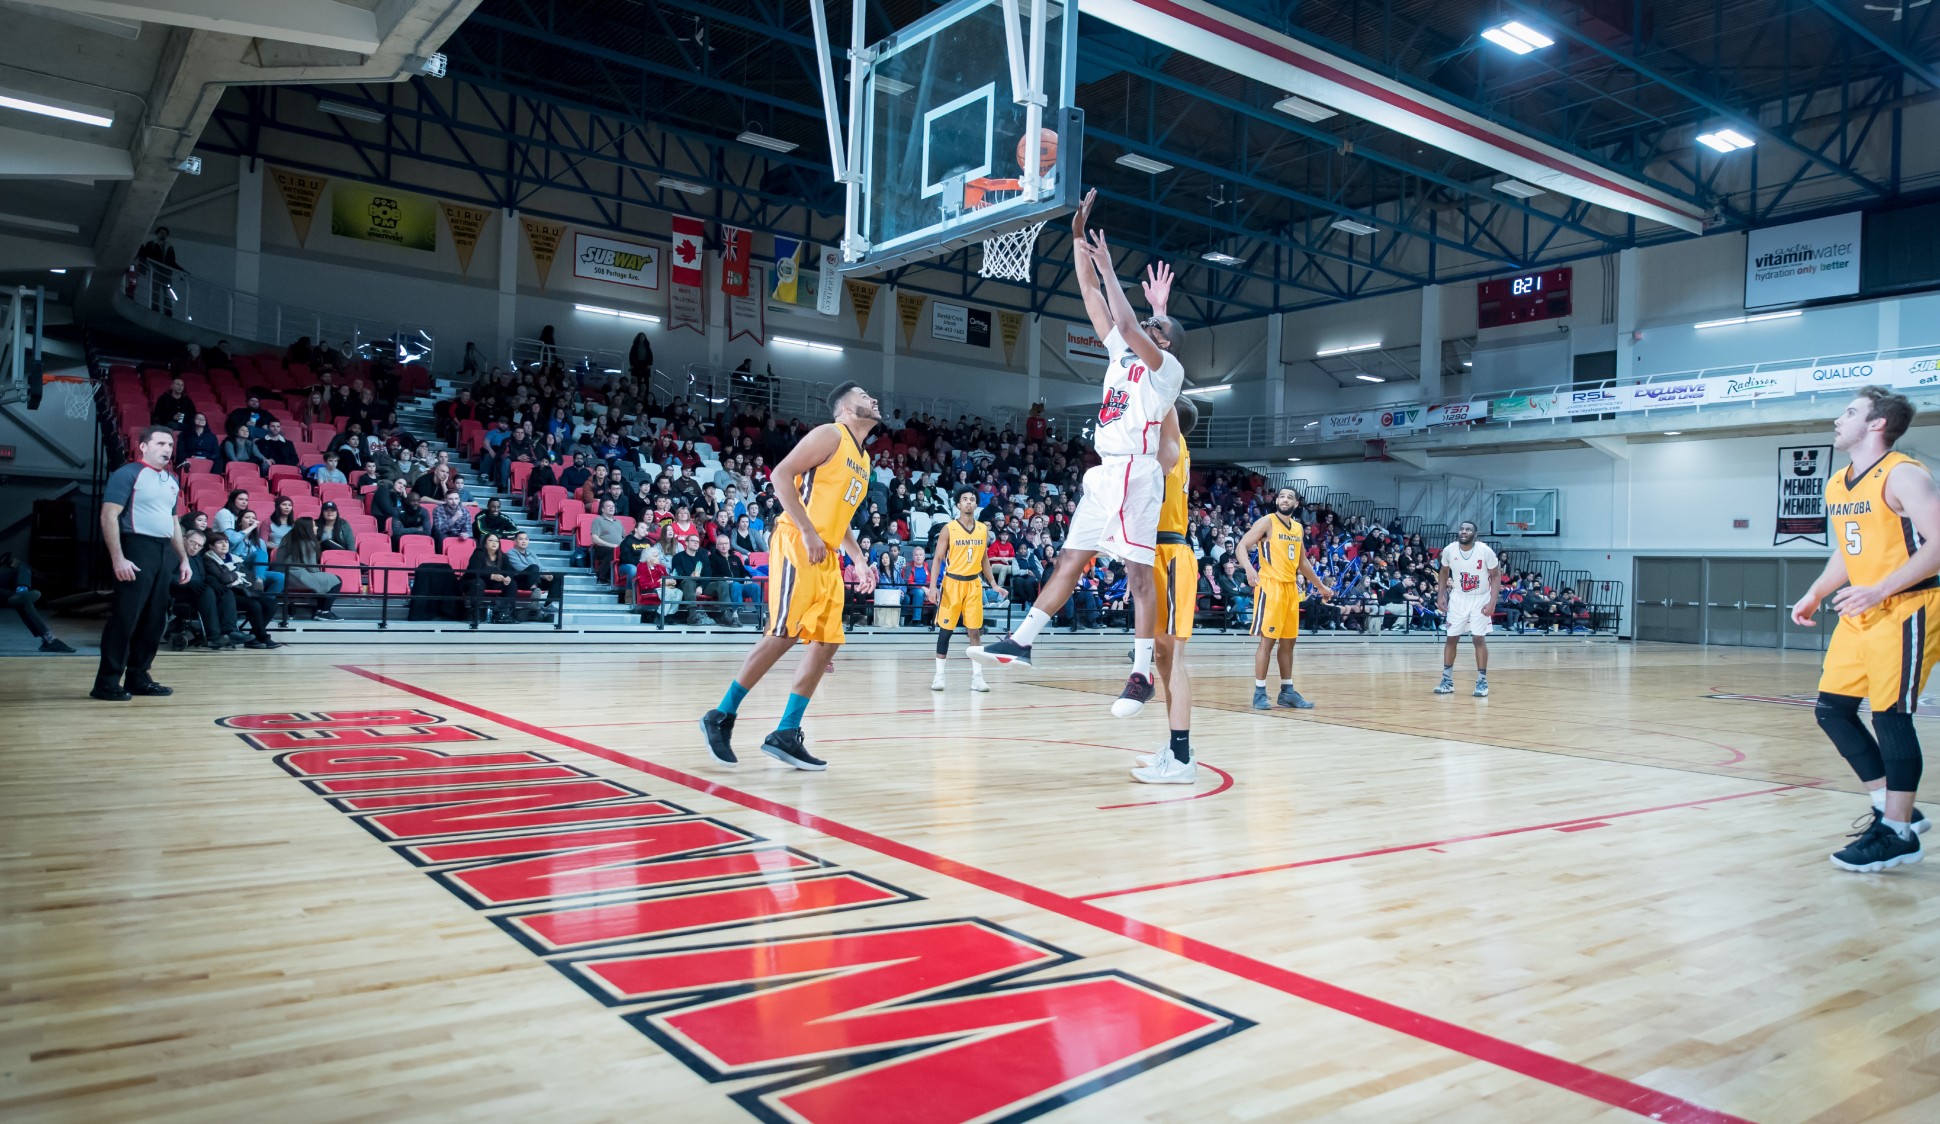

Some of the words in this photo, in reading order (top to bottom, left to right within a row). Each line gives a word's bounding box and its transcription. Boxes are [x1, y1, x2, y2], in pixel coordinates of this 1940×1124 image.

[368, 204, 402, 221] BOB
[373, 217, 396, 228] FM
[580, 246, 653, 272] SUBWAY
[1755, 243, 1853, 268] vitaminwater
[594, 267, 605, 276] 508
[606, 269, 627, 280] Portage
[1755, 269, 1795, 282] hydration
[1797, 264, 1817, 276] only
[1820, 260, 1850, 272] better
[1513, 276, 1541, 295] 8:21
[1127, 363, 1146, 384] 10
[1812, 365, 1874, 381] QUALICO
[1909, 359, 1940, 374] SUB
[1727, 377, 1778, 396] Radisson
[1919, 375, 1938, 385] eat
[1572, 390, 1616, 402] RSL
[1634, 384, 1707, 399] EXCLUSIVE
[1443, 404, 1470, 415] TSN
[843, 476, 863, 507] 13
[1783, 478, 1823, 496] MEMBER
[1783, 498, 1823, 515] MEMBRE
[1829, 500, 1872, 516] MANTOBA
[1845, 521, 1863, 555] 5
[967, 547, 974, 564] 1
[1287, 543, 1296, 561] 6
[1477, 559, 1483, 570] 3
